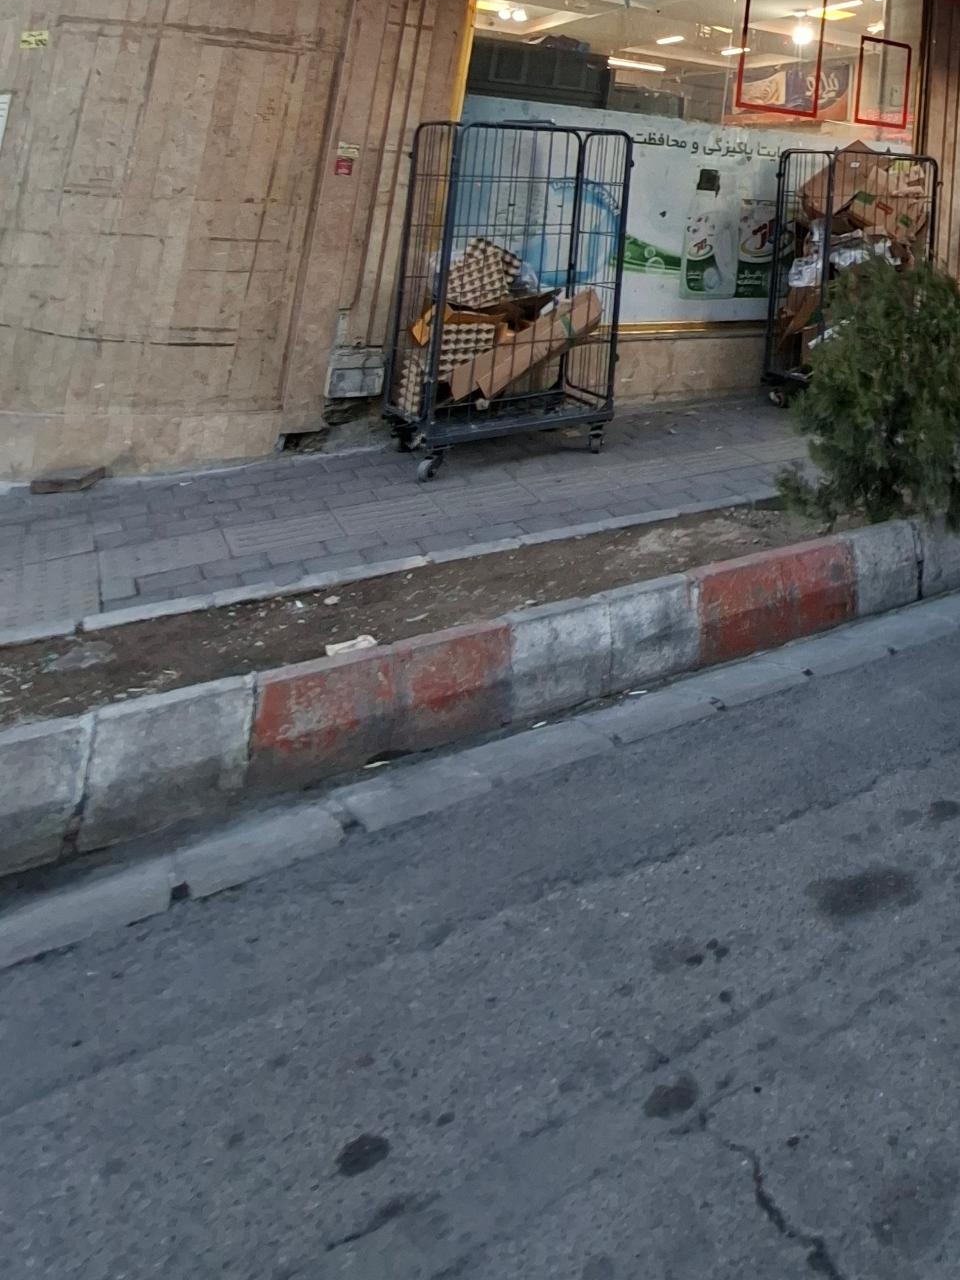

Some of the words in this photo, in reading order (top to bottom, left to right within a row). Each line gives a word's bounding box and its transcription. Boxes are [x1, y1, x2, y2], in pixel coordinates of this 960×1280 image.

[631, 131, 688, 149] محافظت
[691, 140, 699, 154] و
[703, 137, 754, 162] پاکیزگی
